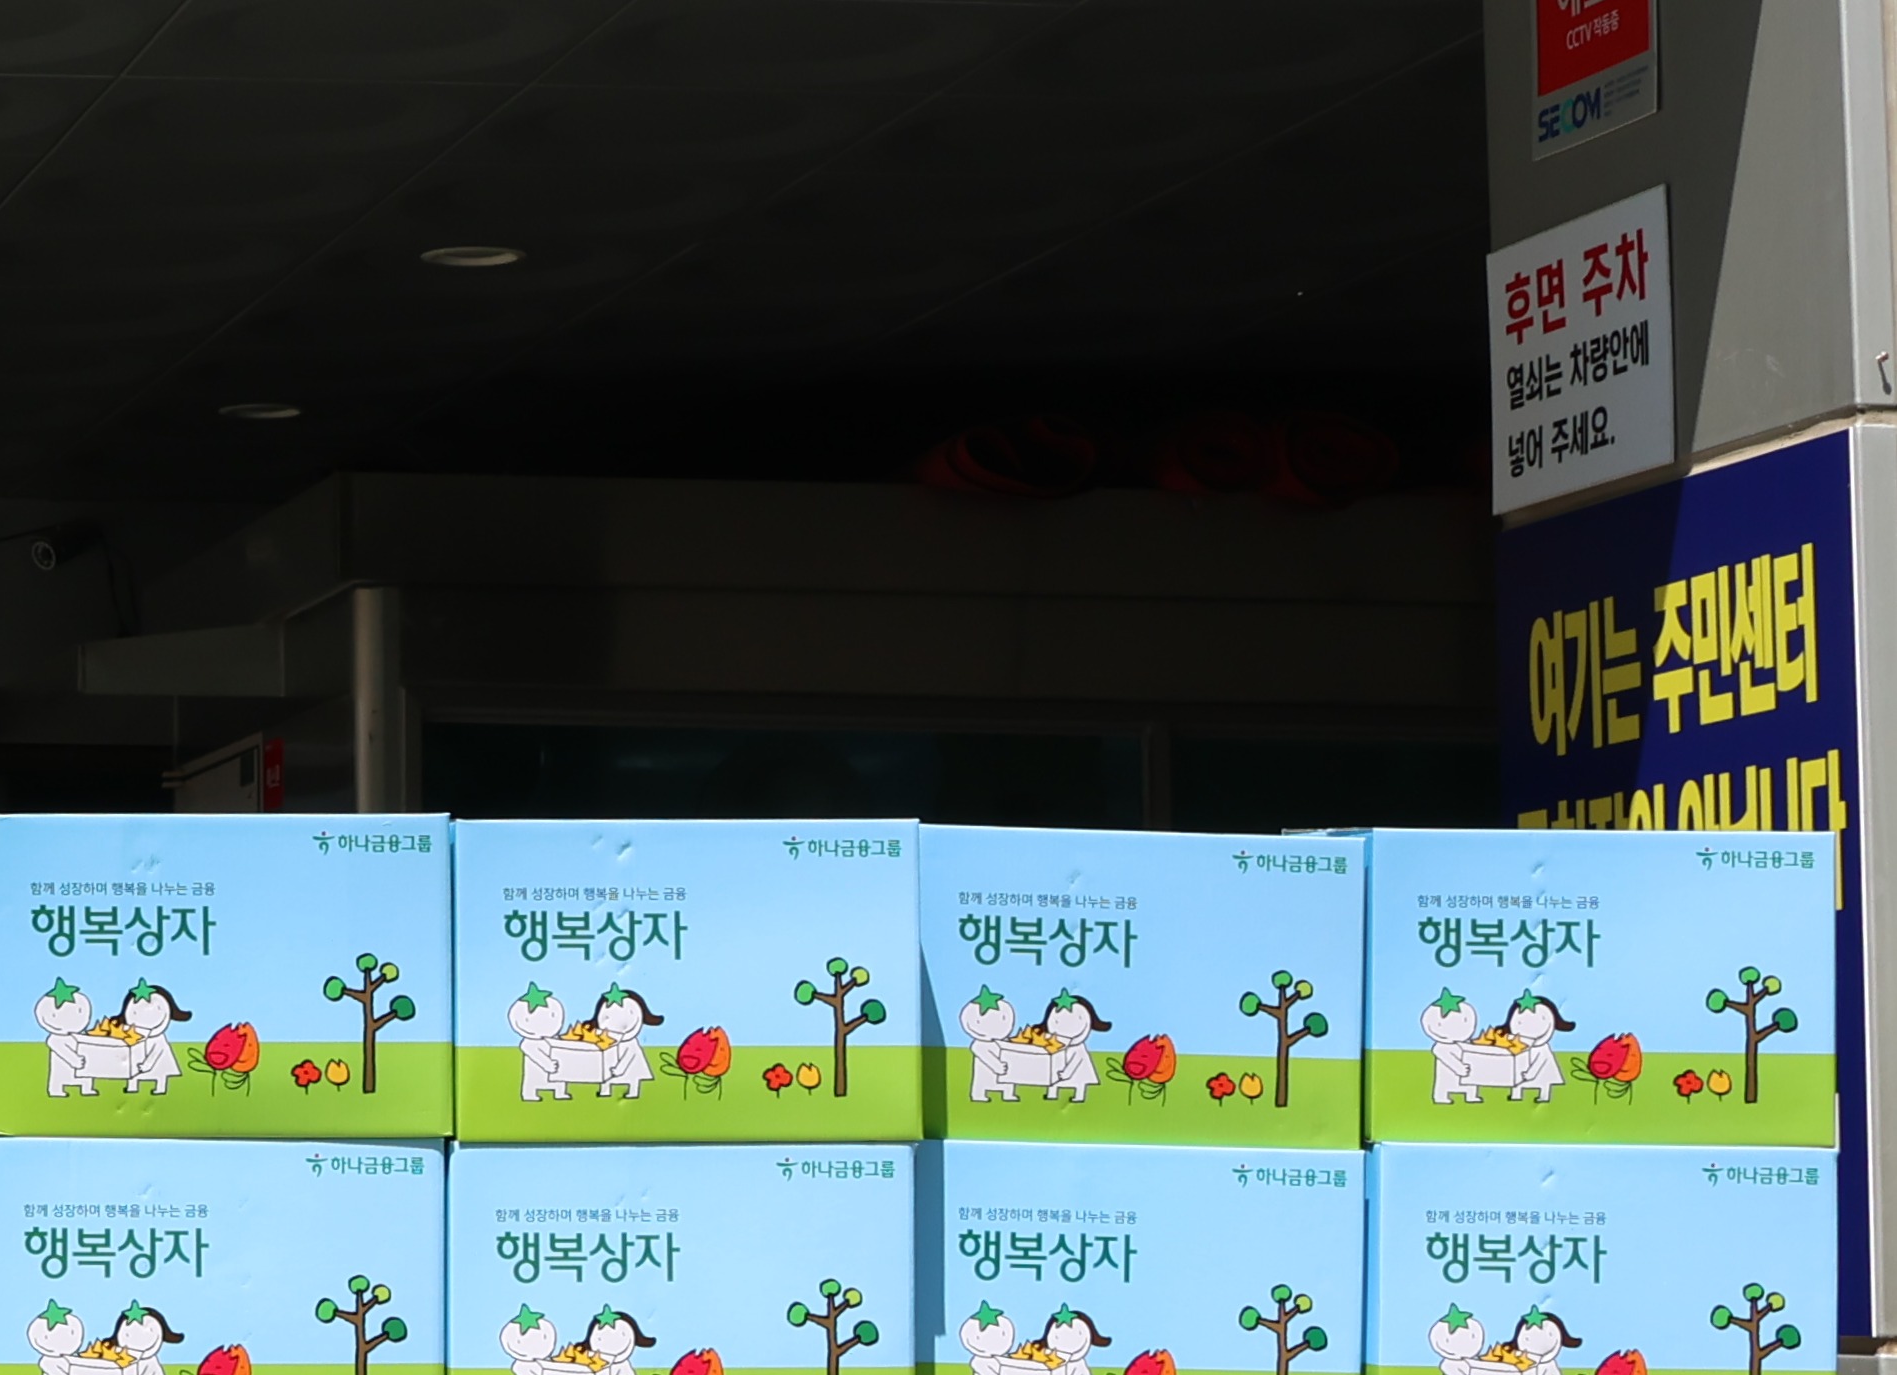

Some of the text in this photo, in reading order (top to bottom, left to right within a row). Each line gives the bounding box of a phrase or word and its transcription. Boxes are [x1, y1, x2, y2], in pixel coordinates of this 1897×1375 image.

[1566, 10, 1619, 50] CCTV 작동중
[1538, 86, 1601, 142] SECOM
[1505, 228, 1649, 345] 후면 주차
[1507, 320, 1650, 410] 열쇠는 차량안에
[1508, 406, 1615, 477] 넣어 주세요.
[1529, 542, 1818, 756] 여기는 주민센터
[337, 833, 432, 854] 하나금융그룹
[807, 838, 902, 858] 하나금융그룹
[1255, 853, 1348, 875] 하나금융그룹
[1720, 849, 1815, 870] 하나금융그룹
[30, 881, 216, 897] 함께 성장하며 행복을 나누는 금융
[30, 904, 217, 958] 행복상자
[503, 909, 688, 962] 행복상자
[958, 913, 1138, 969] 행복상자
[1417, 916, 1601, 969] 행복상자
[330, 1155, 425, 1176] 하나금융그룹
[800, 1159, 896, 1180] 하나금융그룹
[24, 1226, 210, 1279] 행복상자
[496, 1231, 681, 1284] 행복상자
[958, 1228, 1138, 1283] 행복상자
[1425, 1231, 1608, 1285] 행복상자
